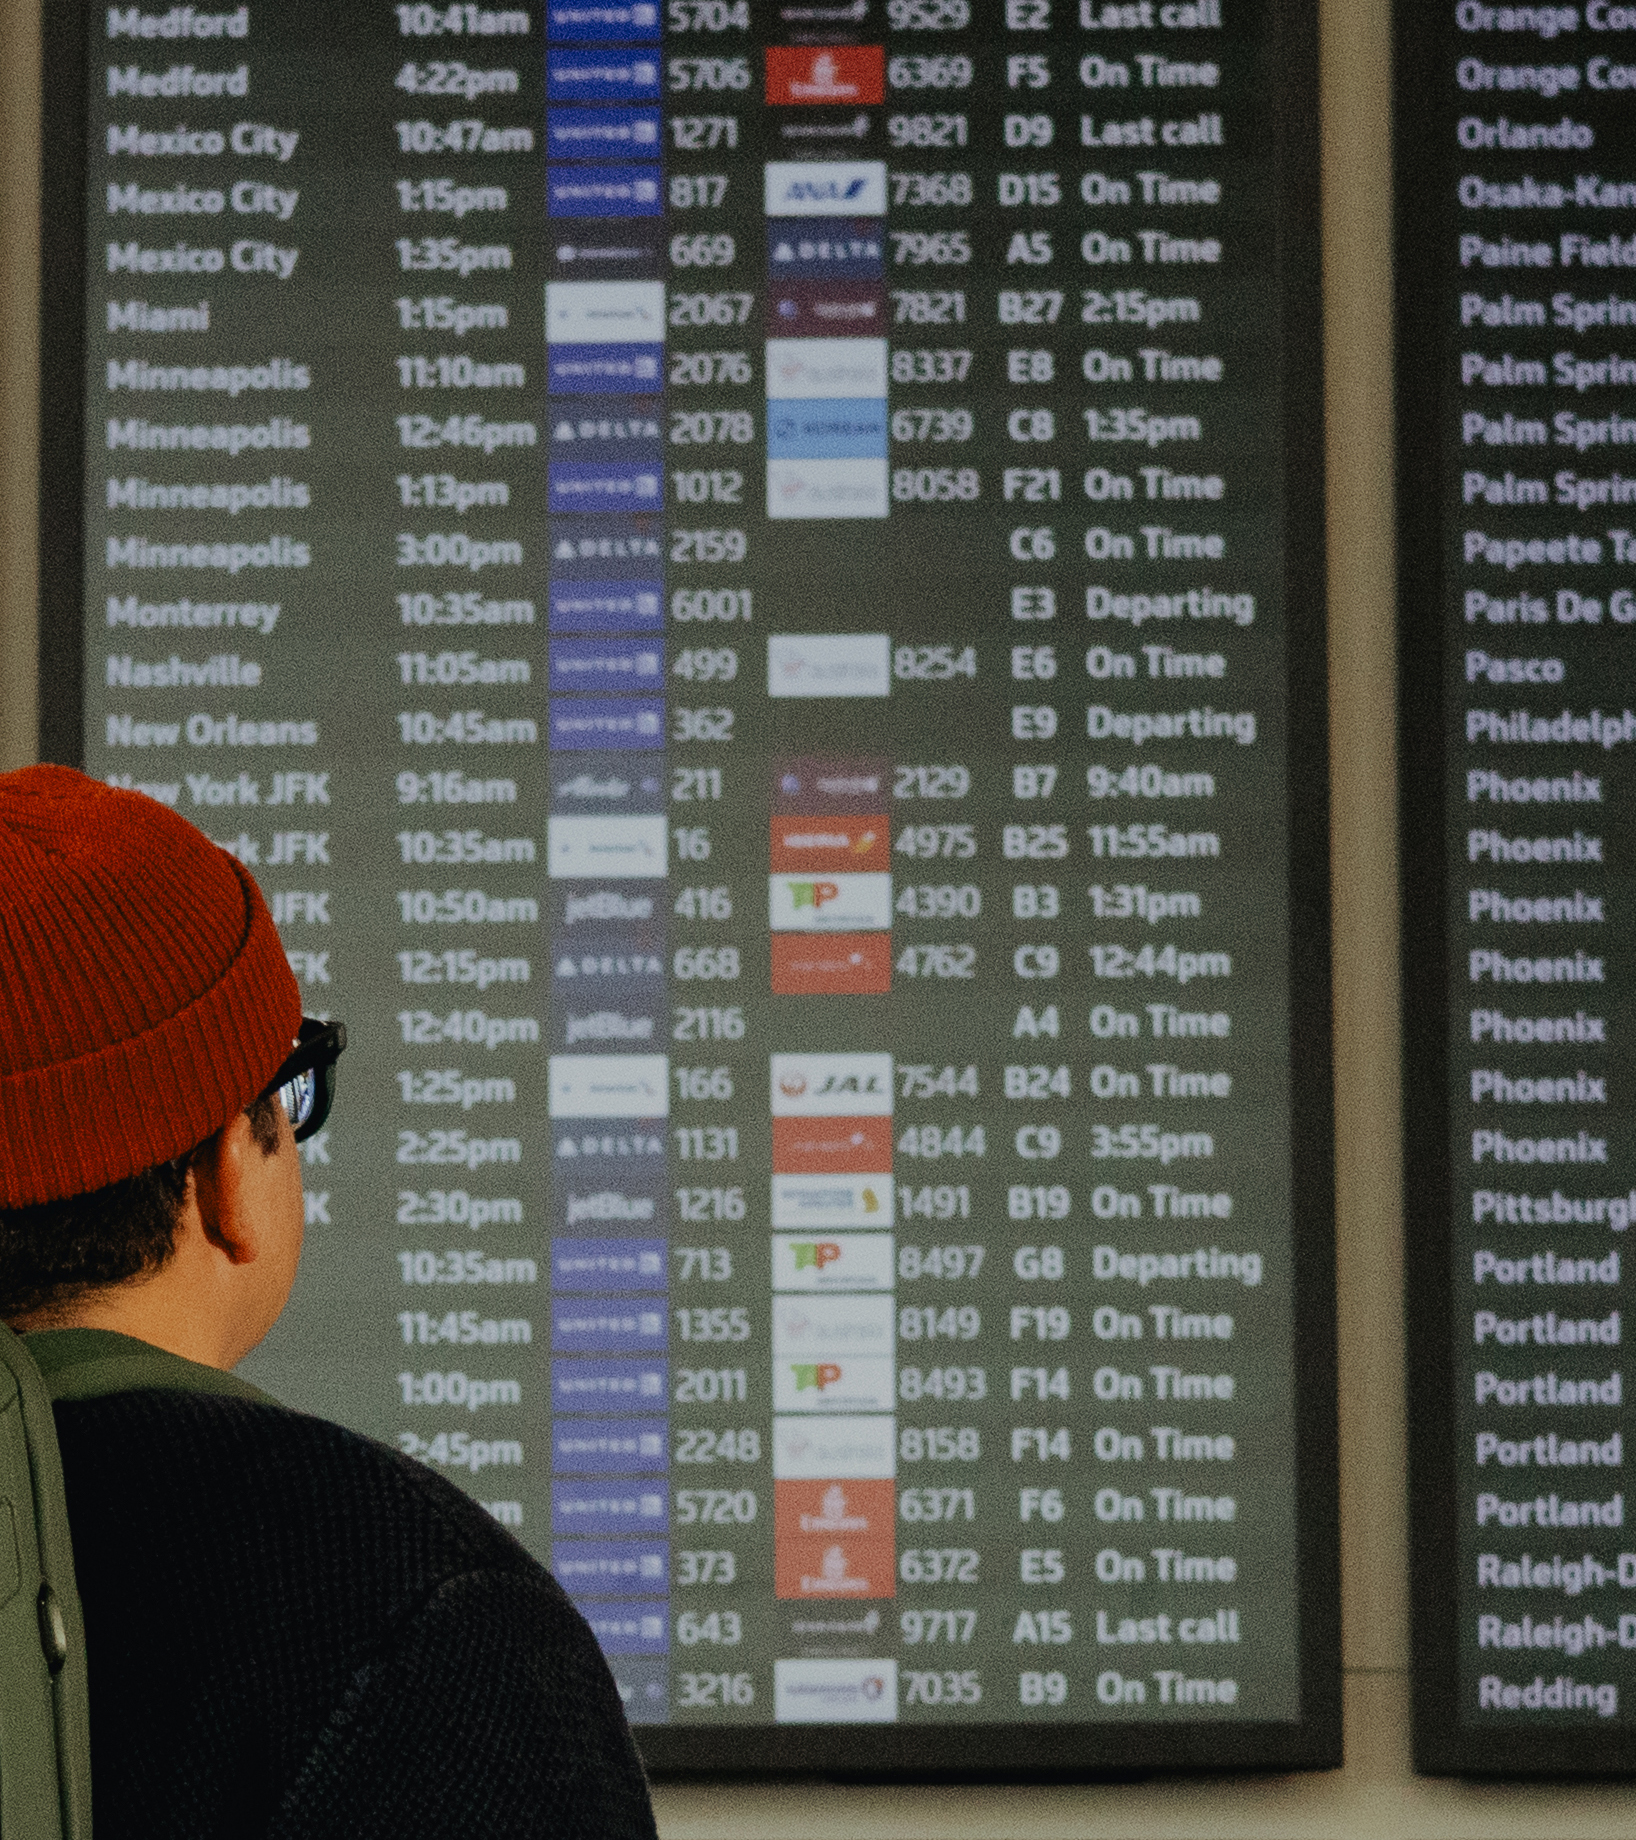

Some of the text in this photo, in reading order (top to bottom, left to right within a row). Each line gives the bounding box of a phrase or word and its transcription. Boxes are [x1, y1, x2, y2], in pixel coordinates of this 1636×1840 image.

[107, 125, 225, 156] Mexico
[230, 122, 299, 161] City
[396, 120, 533, 153] 10:47am
[670, 116, 738, 149] 1271
[1004, 114, 1054, 147] D9
[1081, 116, 1149, 146] Last
[1161, 114, 1222, 145] call
[1463, 472, 1548, 504] Palm
[106, 527, 1056, 574] Minneapolis 3:00pm 2159 C6
[813, 1072, 885, 1096] JAL
